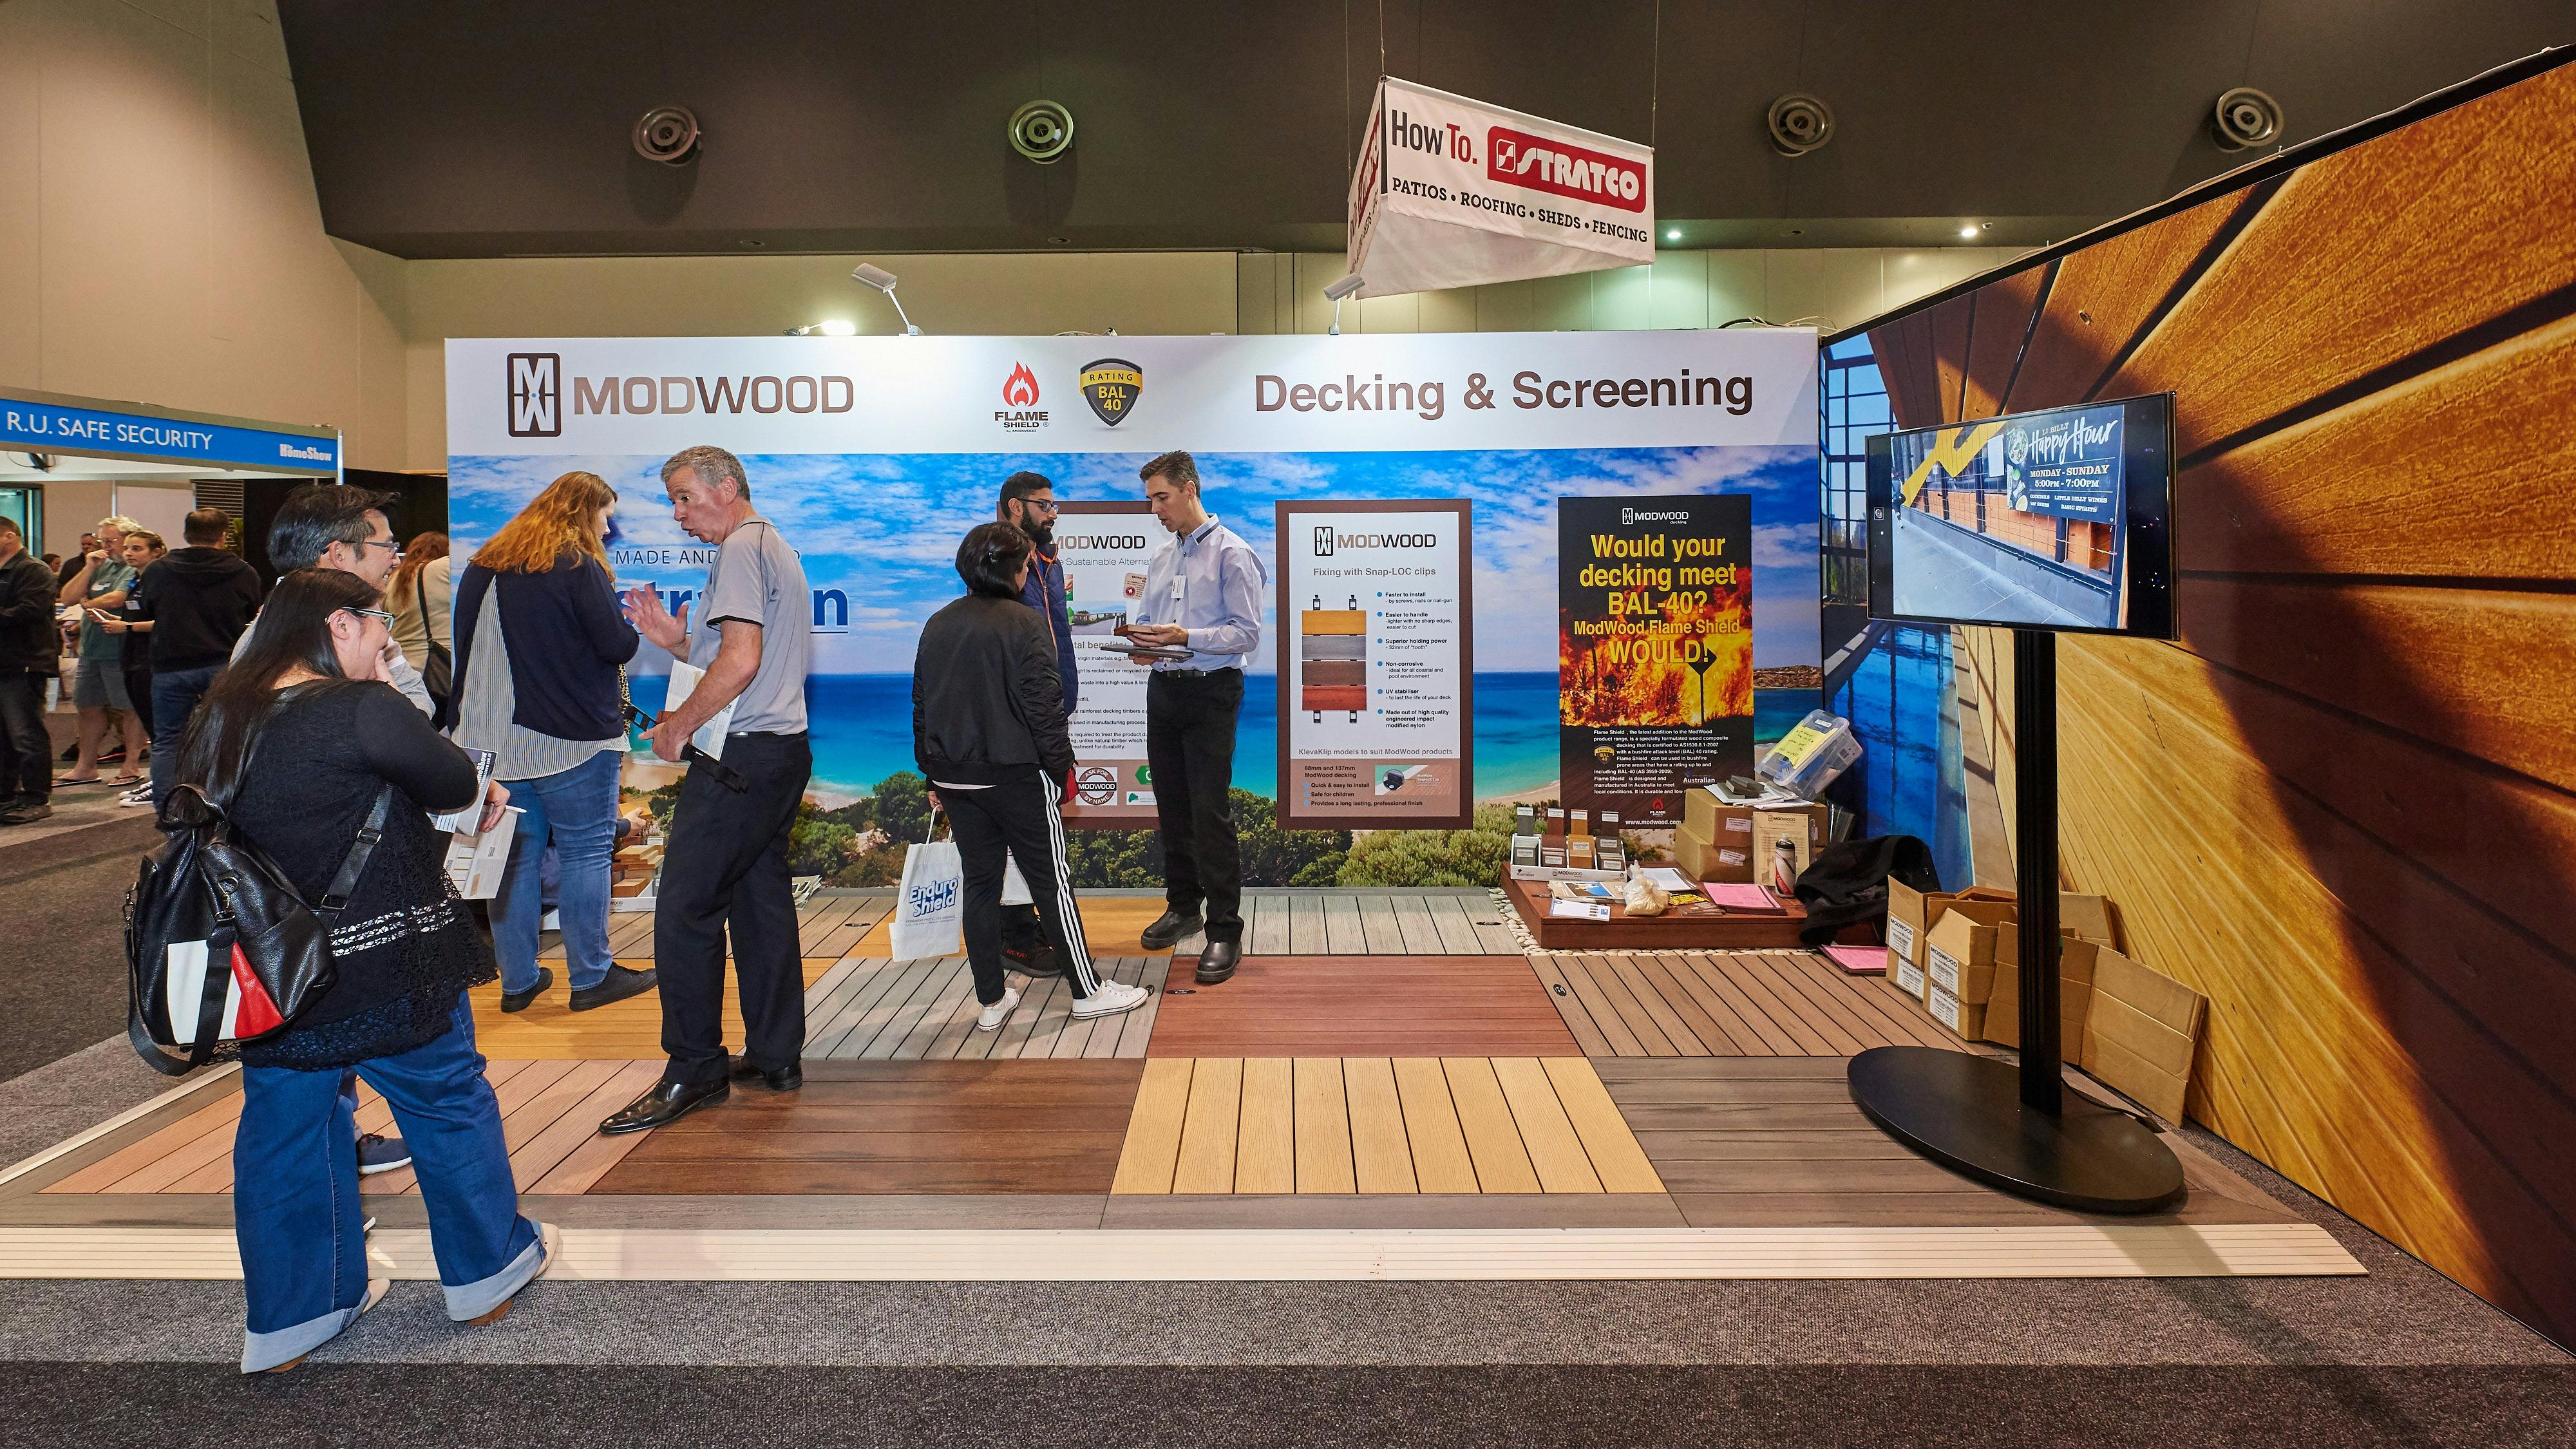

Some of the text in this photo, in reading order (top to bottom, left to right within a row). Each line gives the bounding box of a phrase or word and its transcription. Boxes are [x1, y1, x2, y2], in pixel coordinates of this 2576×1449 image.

[1517, 147, 1639, 200] STRATCO
[1392, 177, 1647, 243] PATIOS ROOFING SHEDS FENCING
[573, 376, 854, 415] MODWOOD
[1098, 386, 1126, 399] BAL
[1256, 368, 1752, 421] Decking & Screening
[1104, 399, 1122, 411] 40
[994, 412, 1048, 421] FLAME
[6, 412, 213, 450] R.U. SAFE SECURITY
[2050, 422, 2069, 433] BILLY
[2029, 417, 2118, 465] Happy Hour
[2030, 465, 2110, 477] MONDAY SUNDAY
[2066, 478, 2099, 487] 7:00PM
[1634, 511, 1689, 520] MODWOOD
[1338, 534, 1436, 548] MODWOOD
[1591, 535, 1725, 562] Would your
[616, 550, 670, 564] MADE
[1314, 568, 1341, 578] Fixing
[1365, 567, 1412, 577] Snap-LOC
[1414, 567, 1436, 577] clips
[1580, 563, 1737, 592] decking meet
[1609, 591, 1707, 614] BAL-40?
[1574, 619, 1740, 634] ModWood Flame Shield
[1609, 640, 1708, 663] WOULD!
[1093, 795, 1110, 804] NAME
[909, 878, 958, 904] Enduro
[913, 890, 956, 917] Shield
[1891, 918, 1913, 935] MODWOOD
[1931, 947, 1957, 967] MODWOOD
[1932, 982, 1958, 1003] MODWOOD
